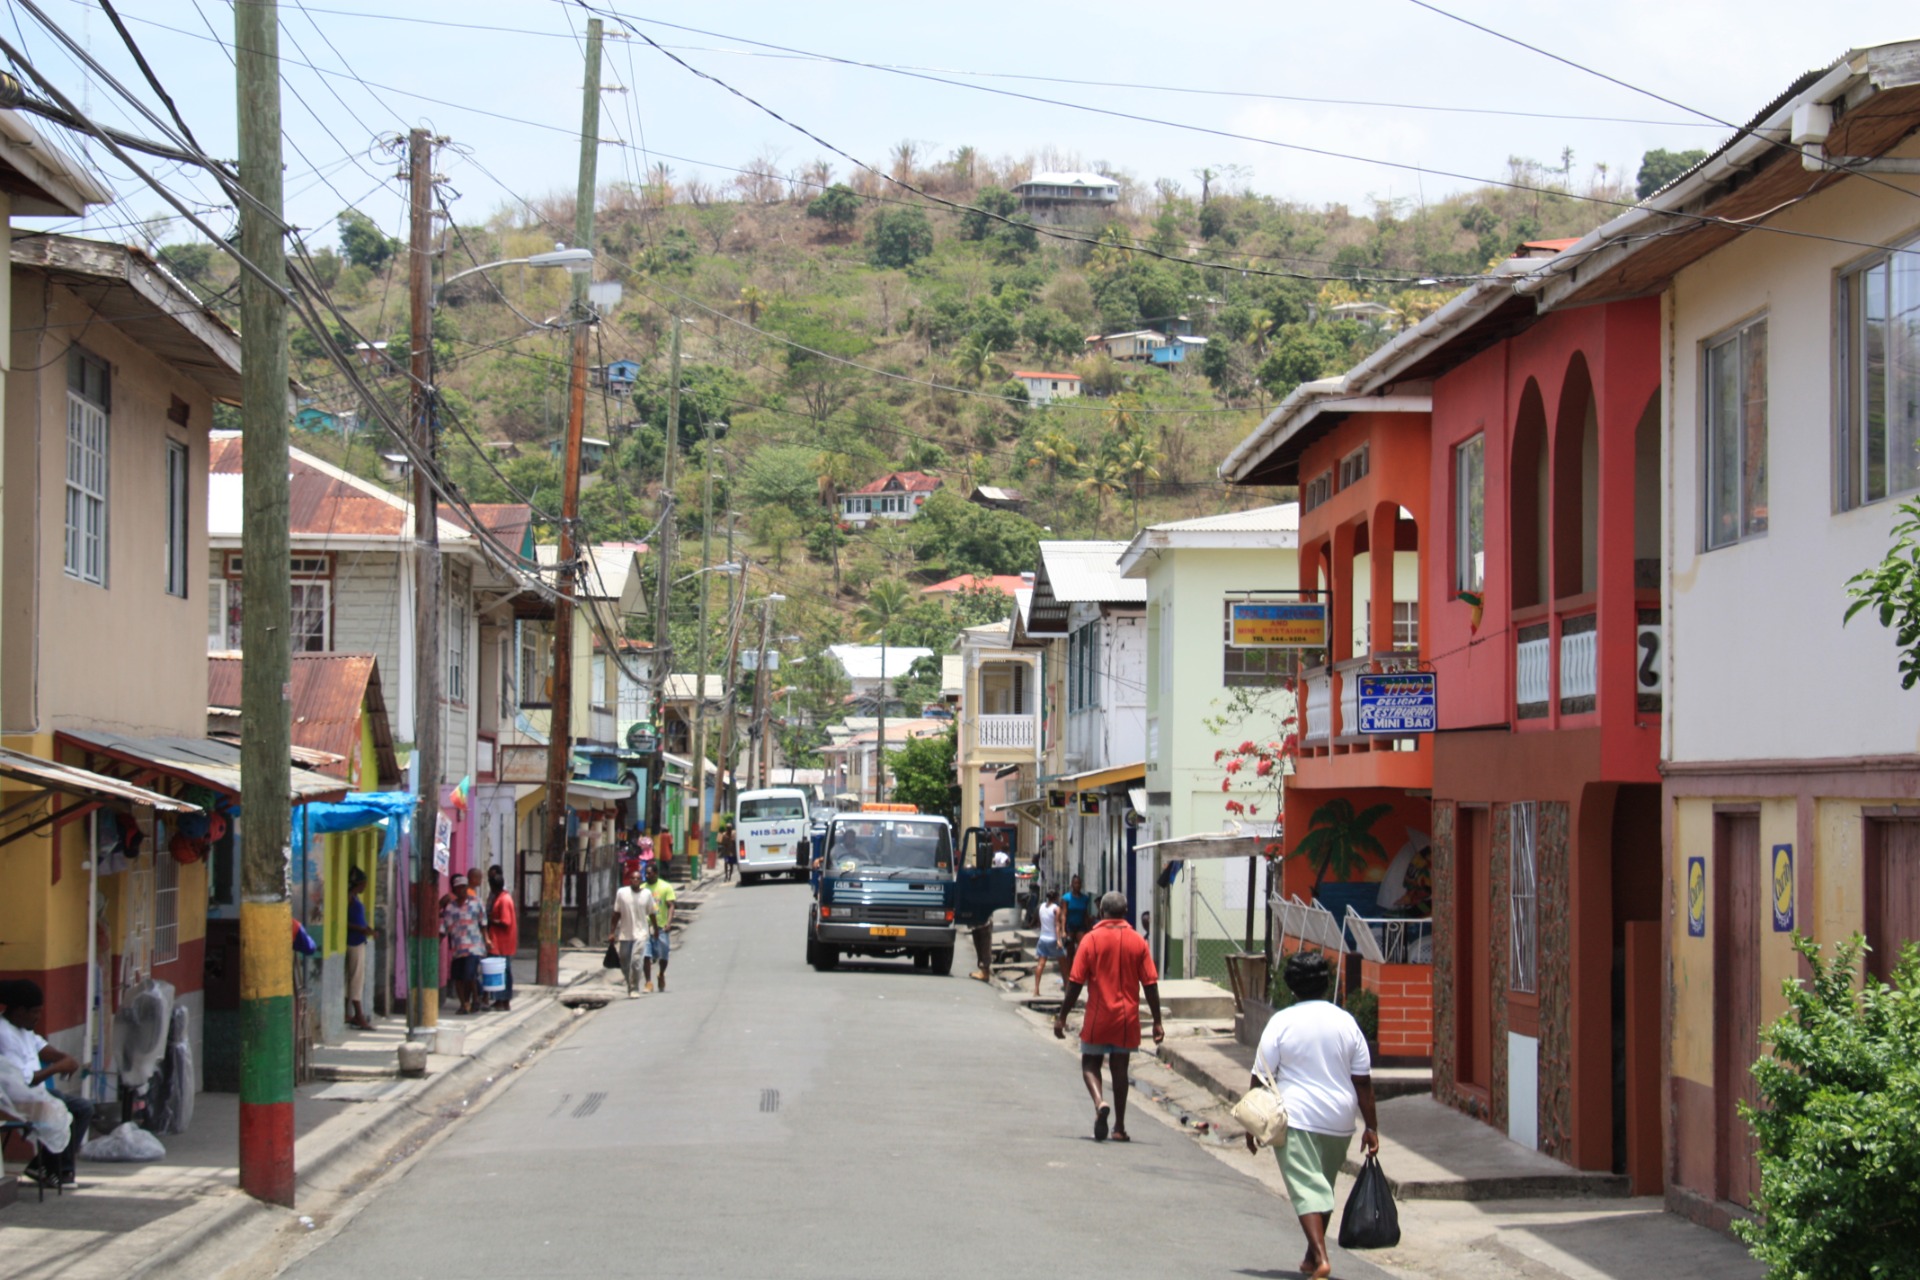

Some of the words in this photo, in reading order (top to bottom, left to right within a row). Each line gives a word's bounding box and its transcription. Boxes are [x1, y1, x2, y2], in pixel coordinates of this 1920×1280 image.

[1376, 698, 1423, 706] DELIGHT
[1362, 704, 1434, 719] RESTAURANT
[1361, 718, 1370, 729] &
[1374, 718, 1400, 729] MINI
[1404, 717, 1431, 728] BAR
[750, 828, 795, 836] NISSAN
